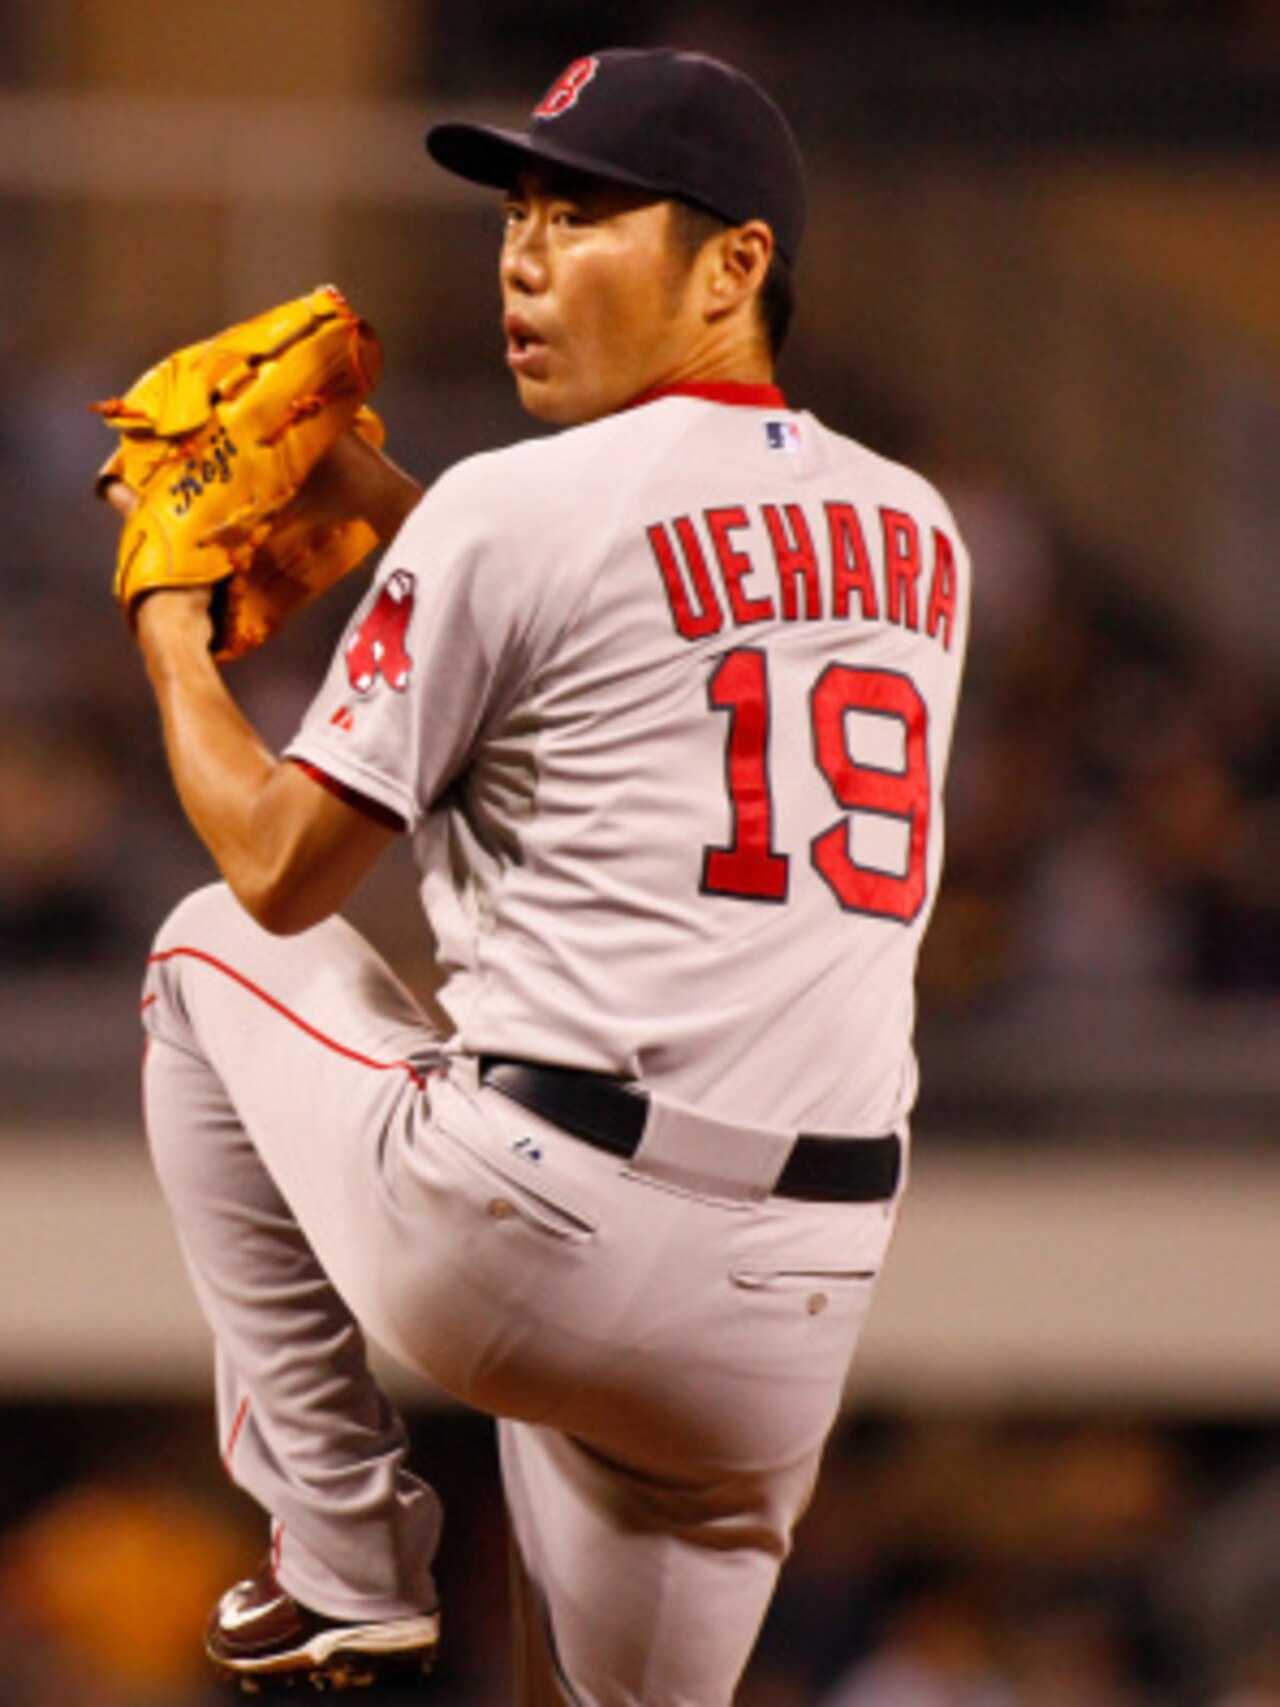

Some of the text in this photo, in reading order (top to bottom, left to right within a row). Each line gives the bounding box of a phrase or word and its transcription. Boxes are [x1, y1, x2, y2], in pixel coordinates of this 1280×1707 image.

[532, 56, 600, 118] B
[171, 426, 237, 515] Koji
[647, 502, 957, 652] UEHARA
[699, 646, 931, 926] 19
